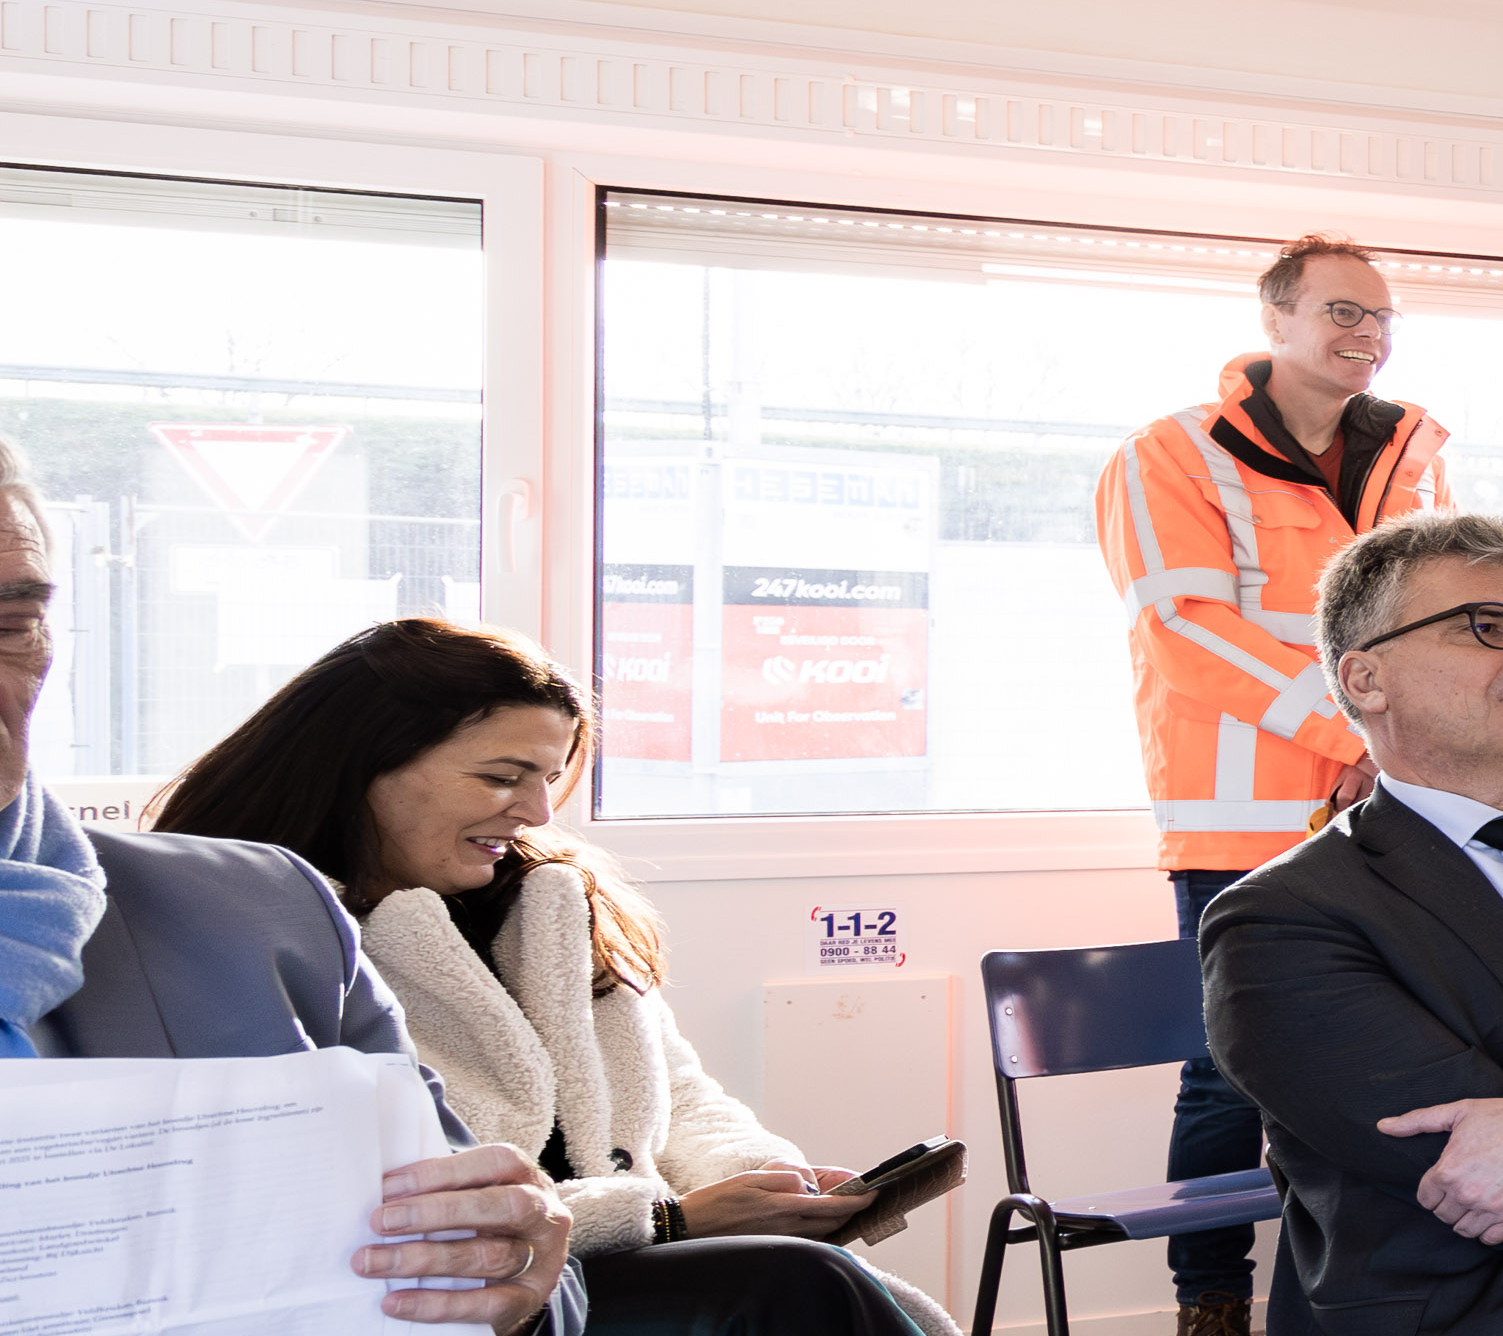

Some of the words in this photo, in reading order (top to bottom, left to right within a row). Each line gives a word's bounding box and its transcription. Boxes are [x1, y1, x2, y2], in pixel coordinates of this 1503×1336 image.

[751, 578, 901, 600] 247kooi.com
[820, 912, 896, 937] 1-1-2
[820, 947, 849, 957] 0900
[863, 946, 877, 955] 88
[882, 945, 896, 954] 44
